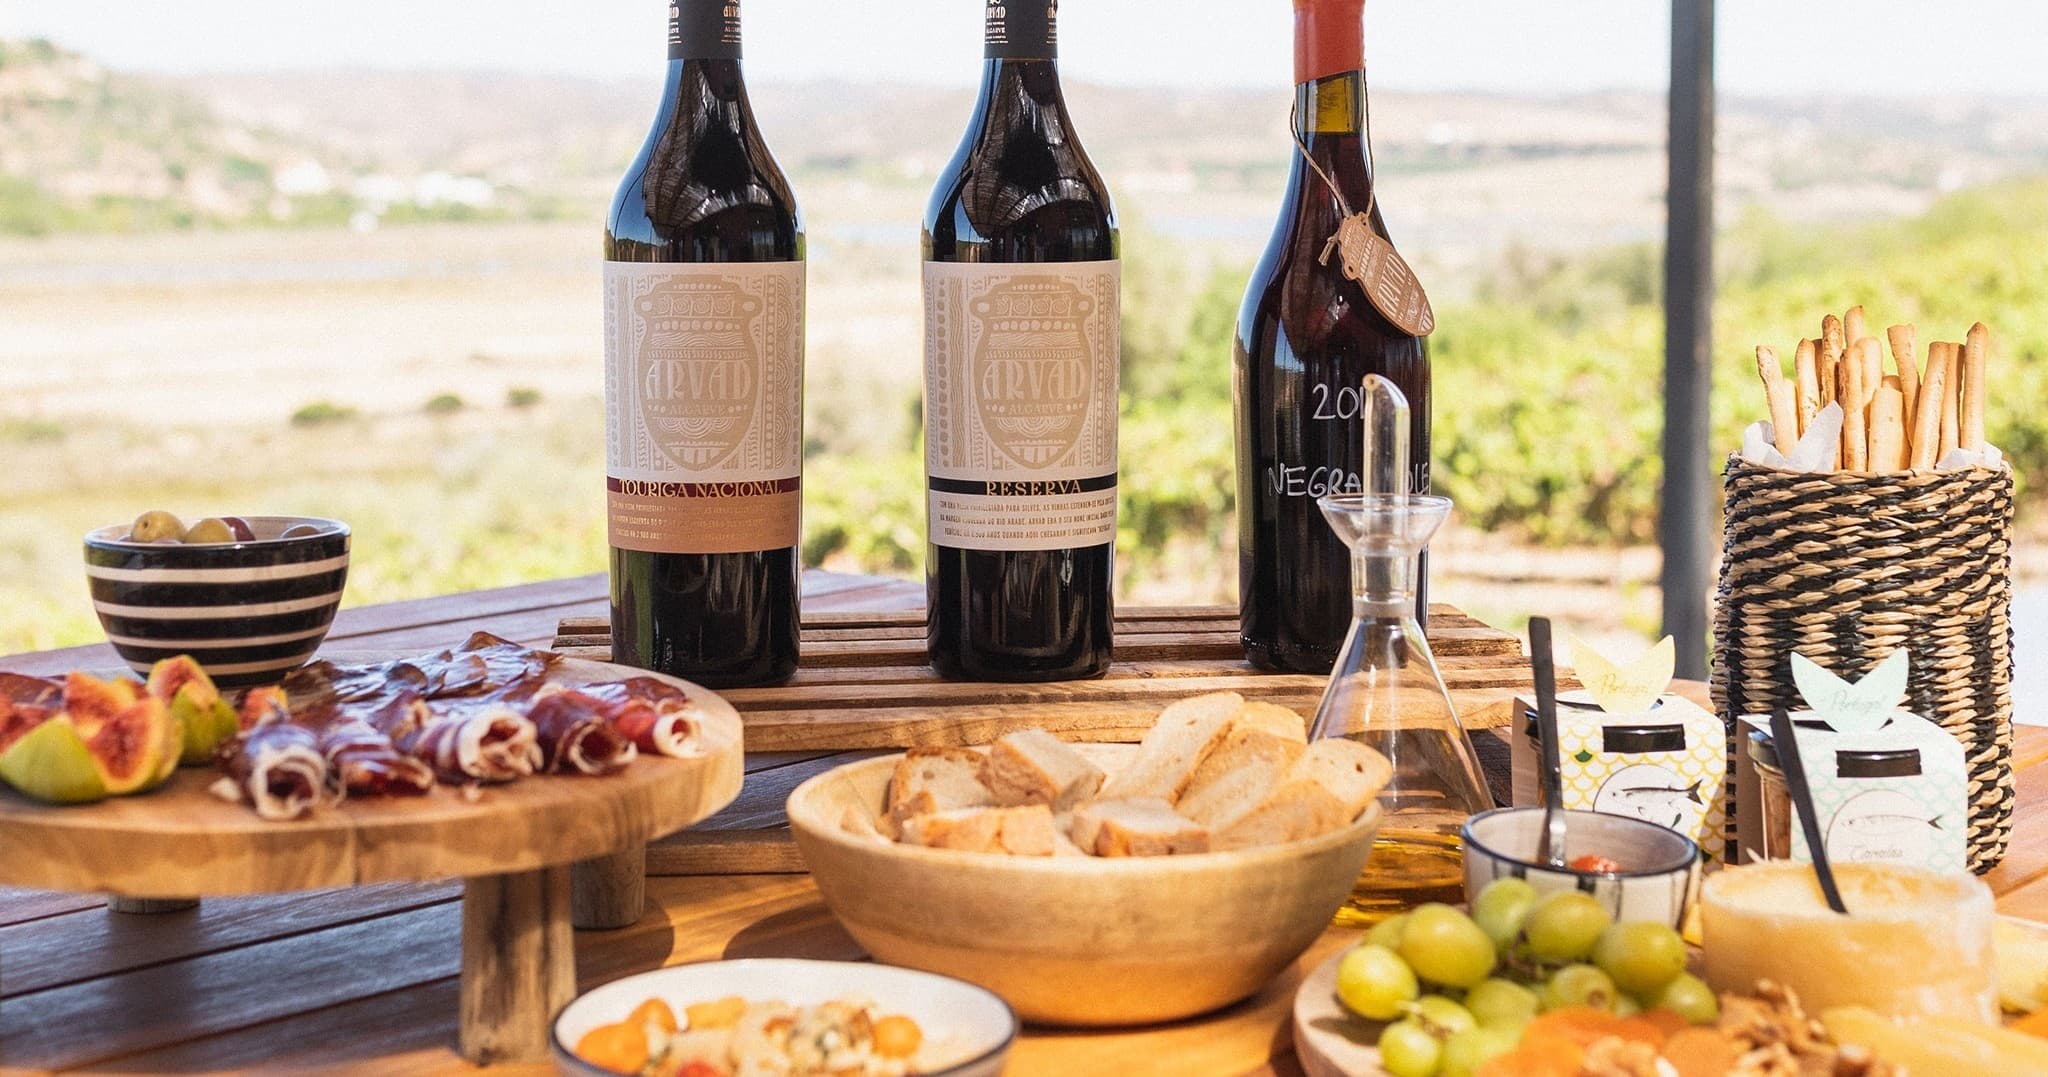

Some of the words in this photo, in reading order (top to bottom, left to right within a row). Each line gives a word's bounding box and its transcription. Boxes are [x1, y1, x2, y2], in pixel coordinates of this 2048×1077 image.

[645, 360, 751, 400] ARVAD
[982, 360, 1086, 400] ARVAD
[1312, 383, 1365, 419] 201
[618, 479, 690, 498] TOURIGA
[695, 480, 782, 498] NACIONAL
[986, 480, 1081, 496] RESERVA
[1268, 463, 1362, 498] NEGRA
